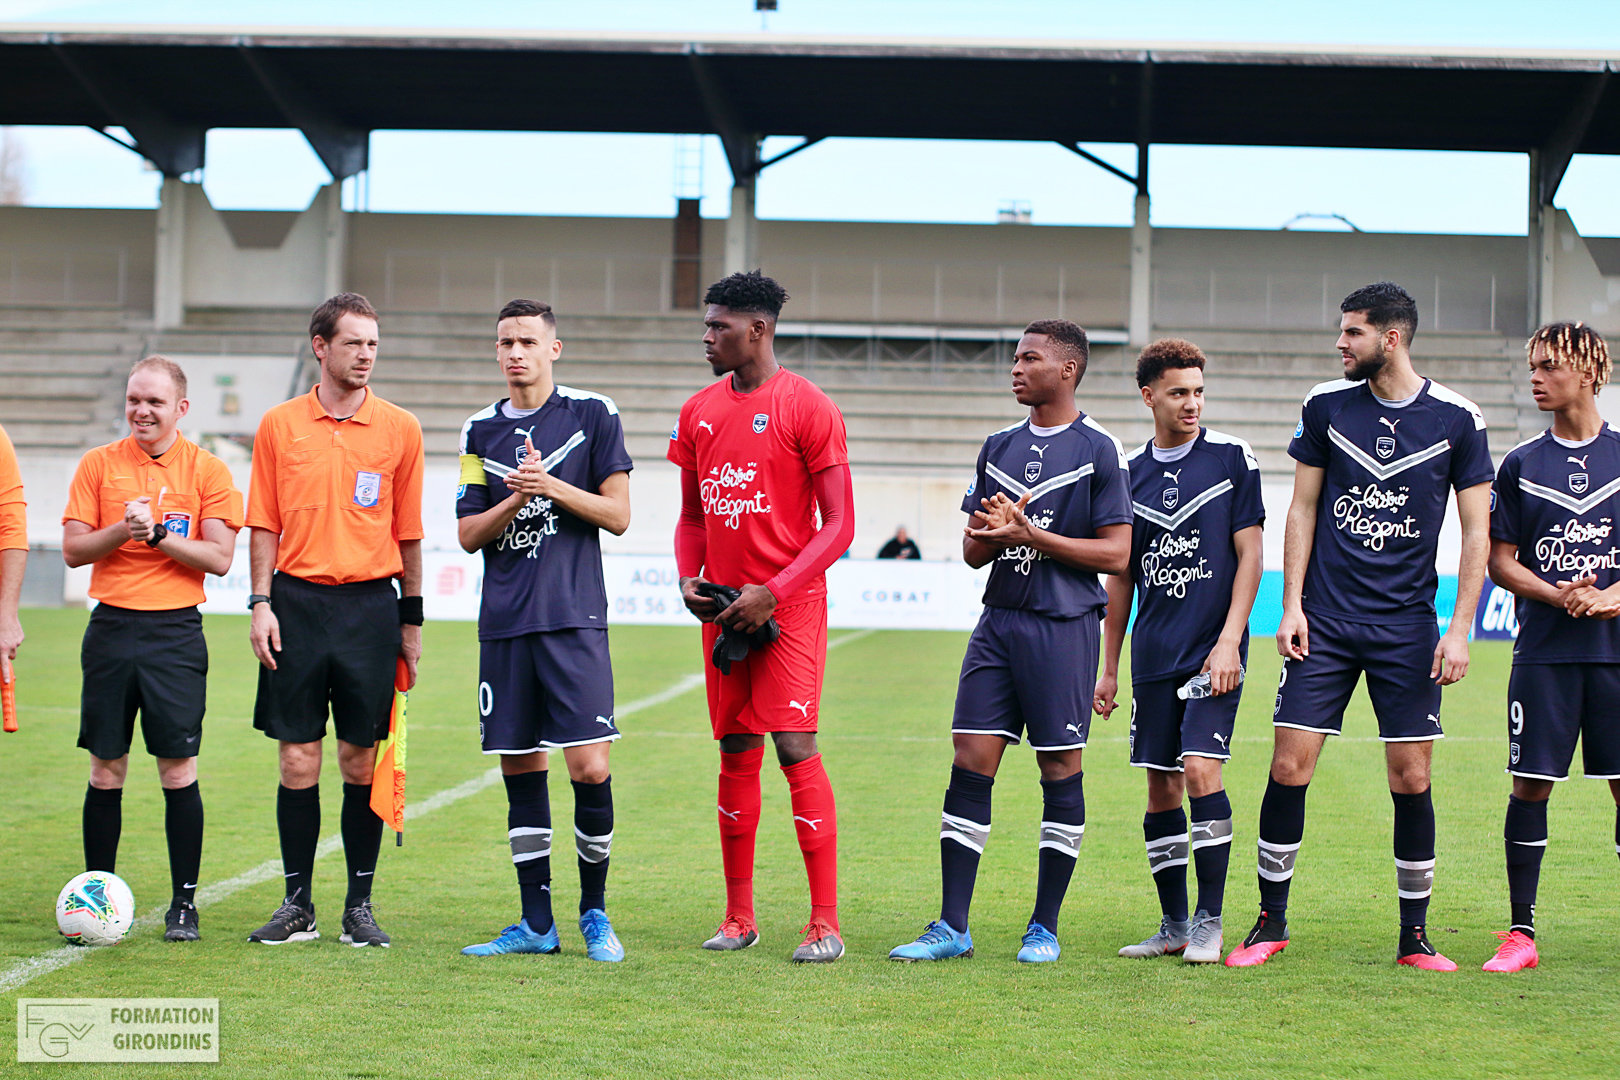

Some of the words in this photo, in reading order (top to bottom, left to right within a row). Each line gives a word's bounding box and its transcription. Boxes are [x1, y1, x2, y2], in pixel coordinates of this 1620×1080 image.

[631, 569, 679, 586] AQU
[861, 590, 930, 602] COBAT
[673, 597, 684, 614] 3
[1510, 700, 1524, 735] 9
